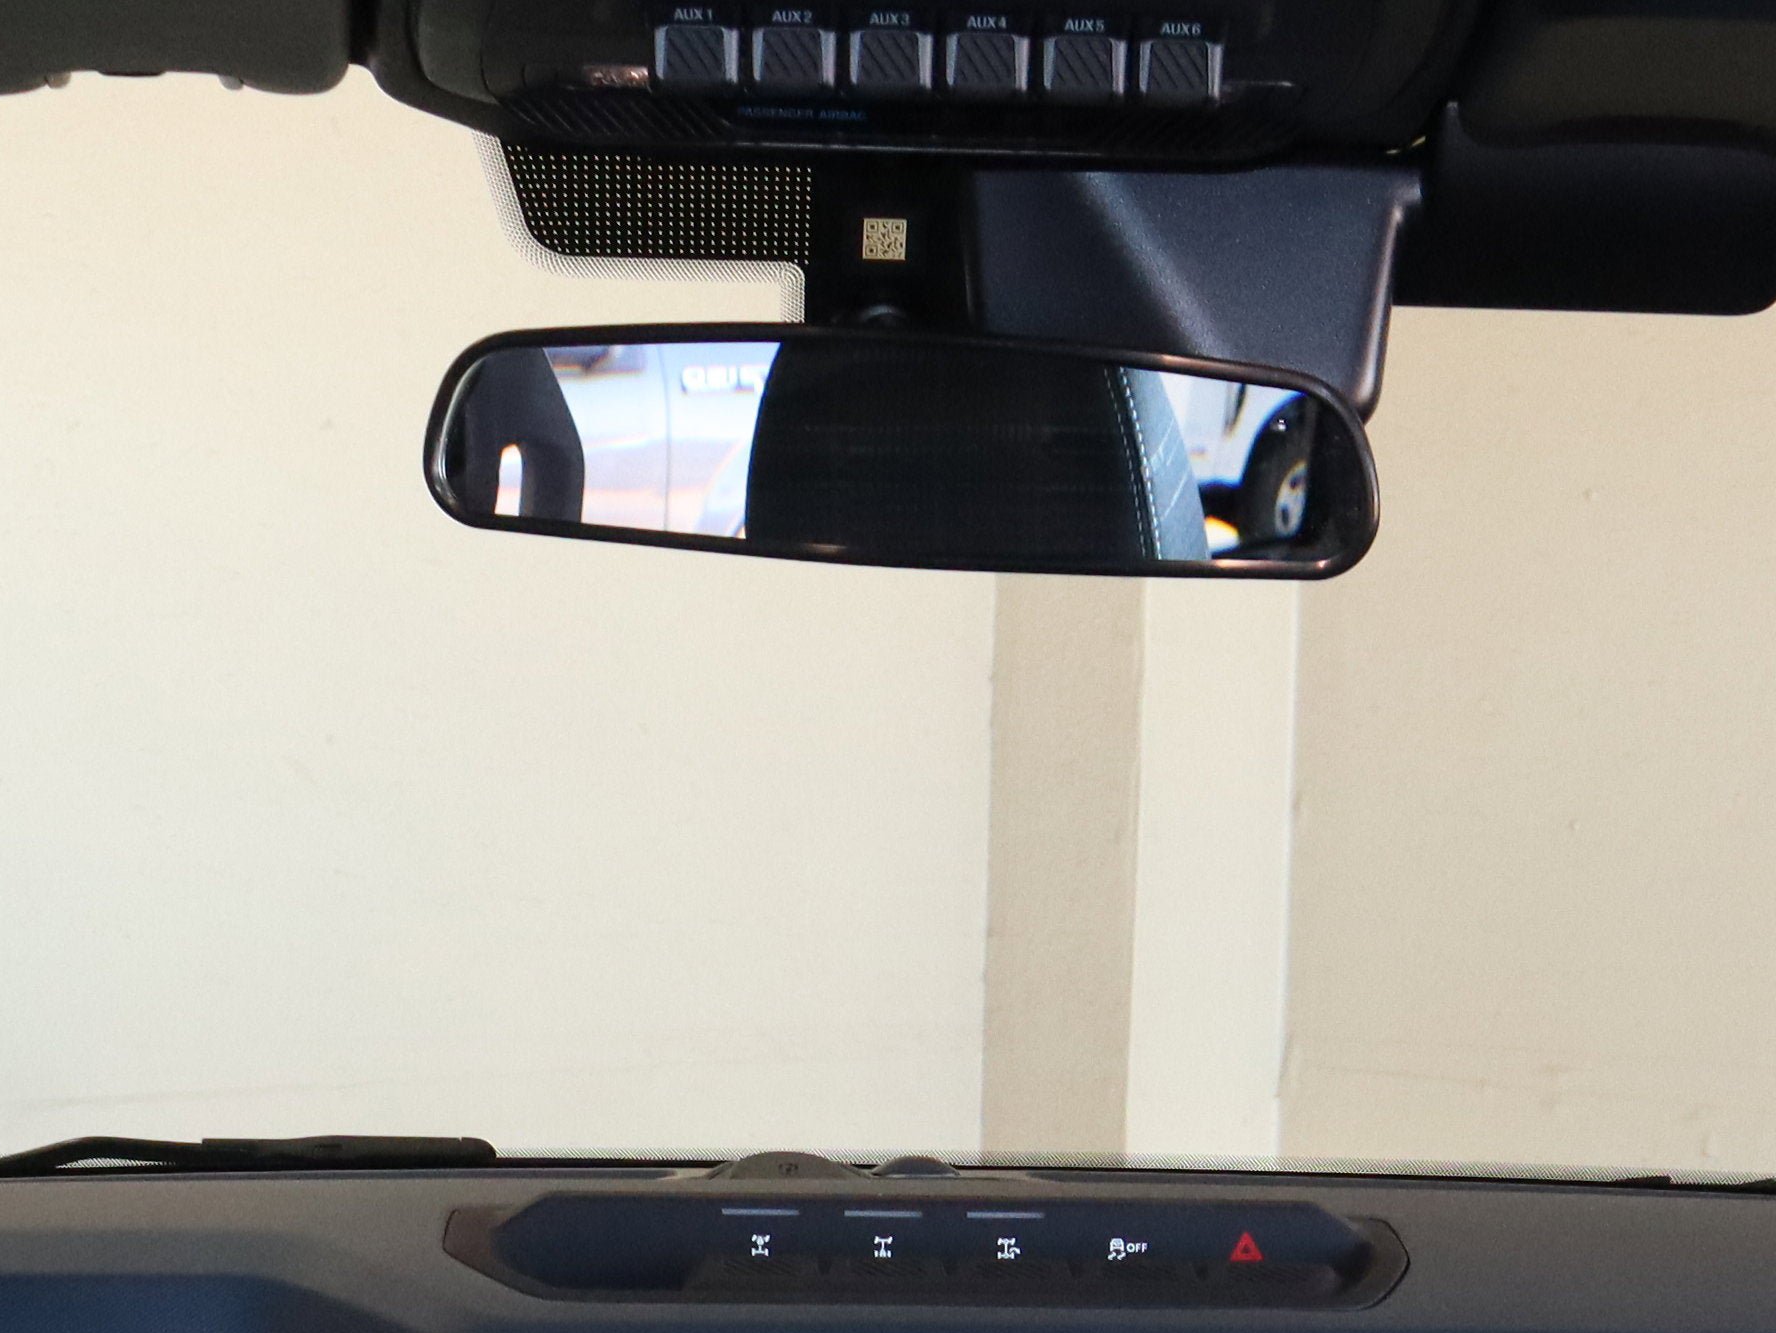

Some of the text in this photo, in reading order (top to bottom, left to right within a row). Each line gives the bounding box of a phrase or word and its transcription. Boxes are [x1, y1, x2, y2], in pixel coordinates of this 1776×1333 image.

[674, 9, 713, 20] AUX 1
[773, 10, 812, 23] AUX 2
[869, 13, 909, 25] AUX 3
[967, 16, 1007, 29] AUX 4
[1064, 19, 1104, 32] AUX 5
[1161, 23, 1201, 35] AUX 6
[1126, 1243, 1148, 1253] OFF
